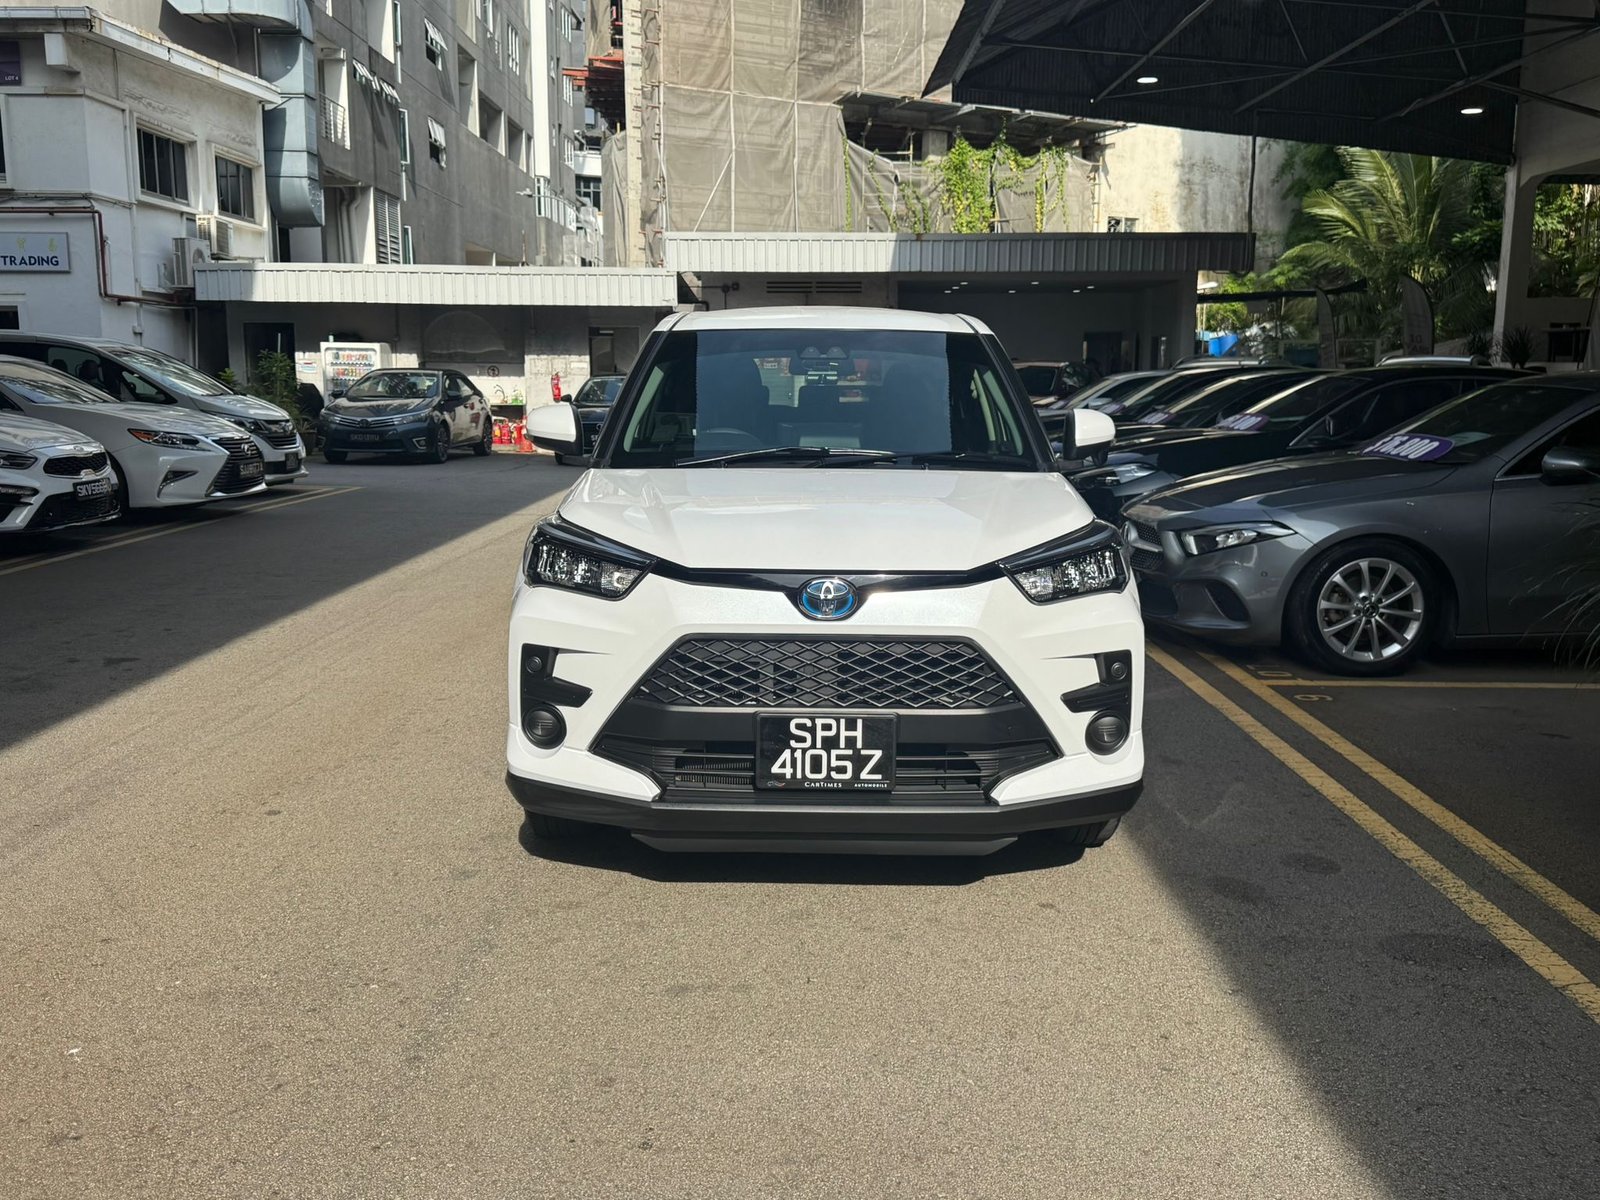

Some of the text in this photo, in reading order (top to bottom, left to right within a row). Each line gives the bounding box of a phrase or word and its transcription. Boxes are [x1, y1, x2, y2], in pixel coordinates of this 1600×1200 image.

[0, 255, 60, 267] TRADING
[789, 717, 863, 749] SPH
[770, 748, 883, 780] 4105 Z
